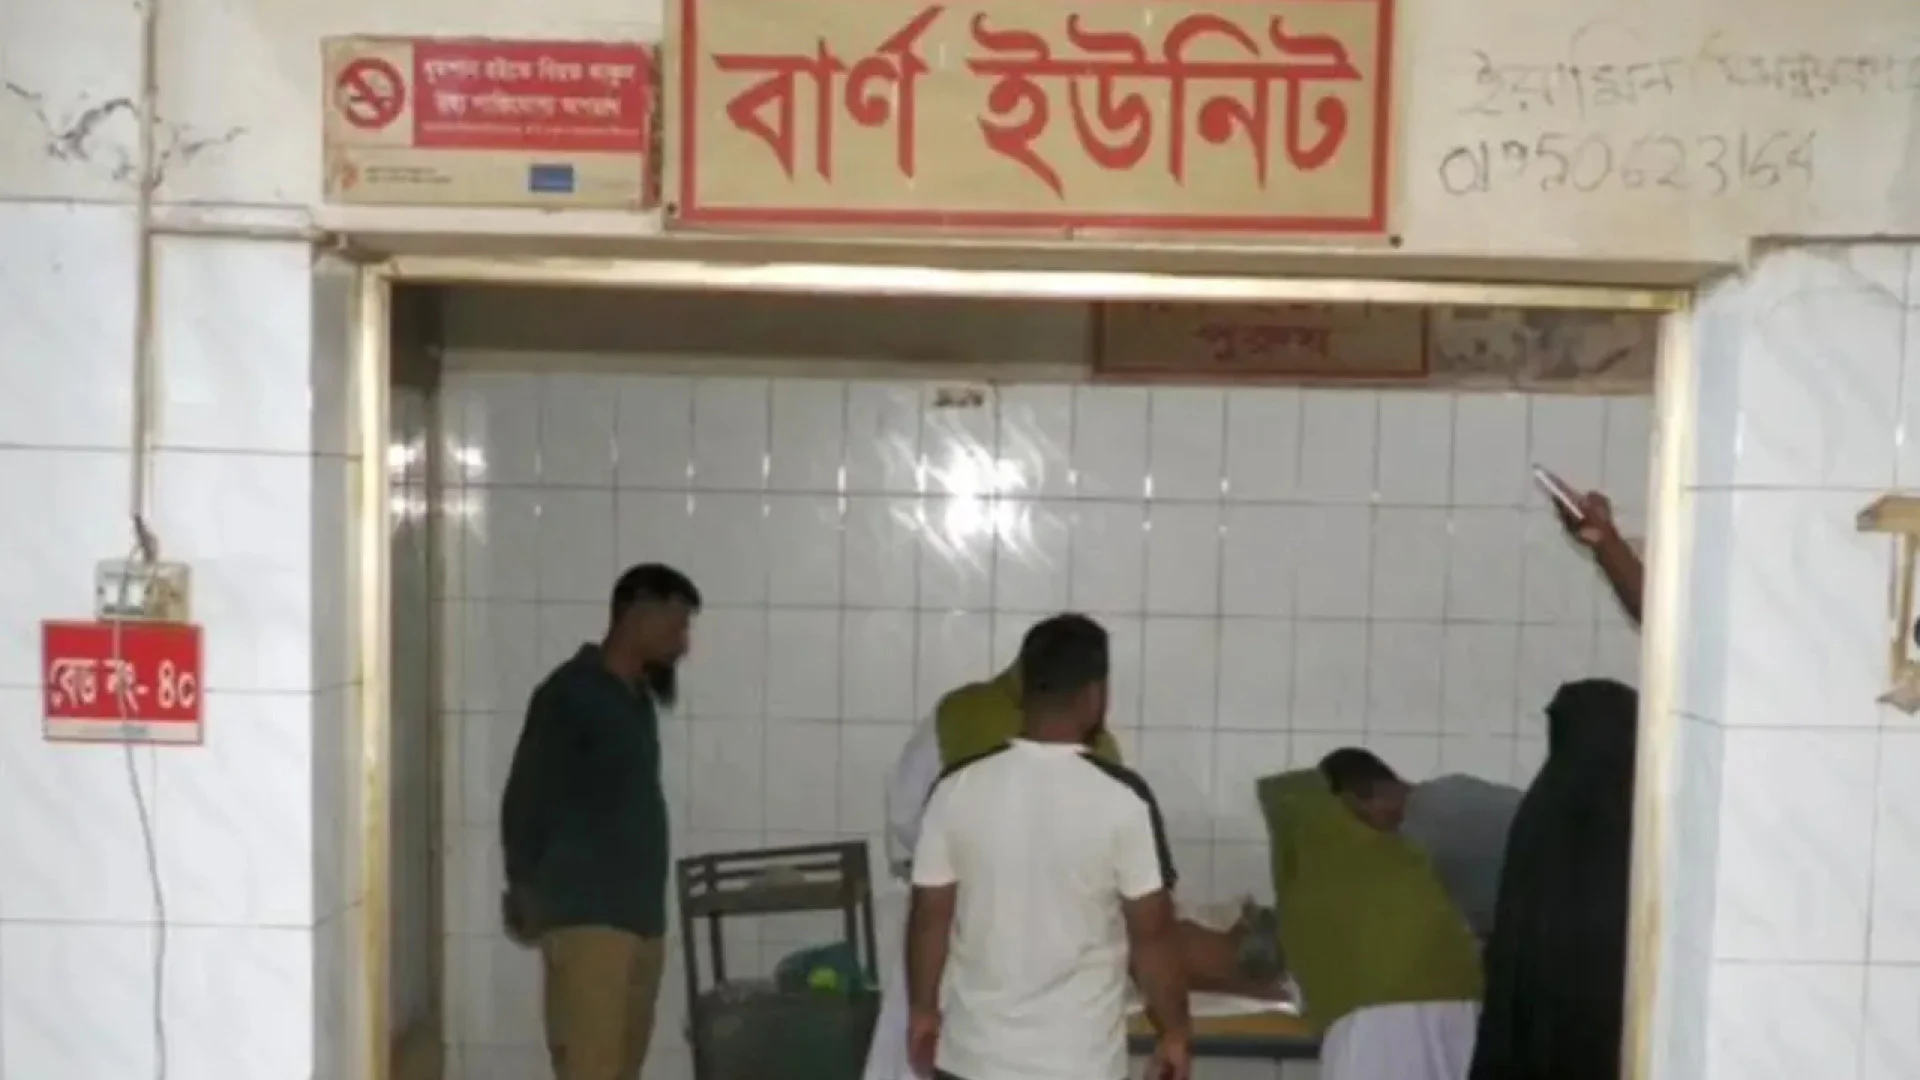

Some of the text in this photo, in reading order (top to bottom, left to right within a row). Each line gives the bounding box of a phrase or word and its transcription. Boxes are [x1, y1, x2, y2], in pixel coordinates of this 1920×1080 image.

[711, 5, 1364, 200] বার্ণ ইউনিট
[51, 657, 98, 708] বেড
